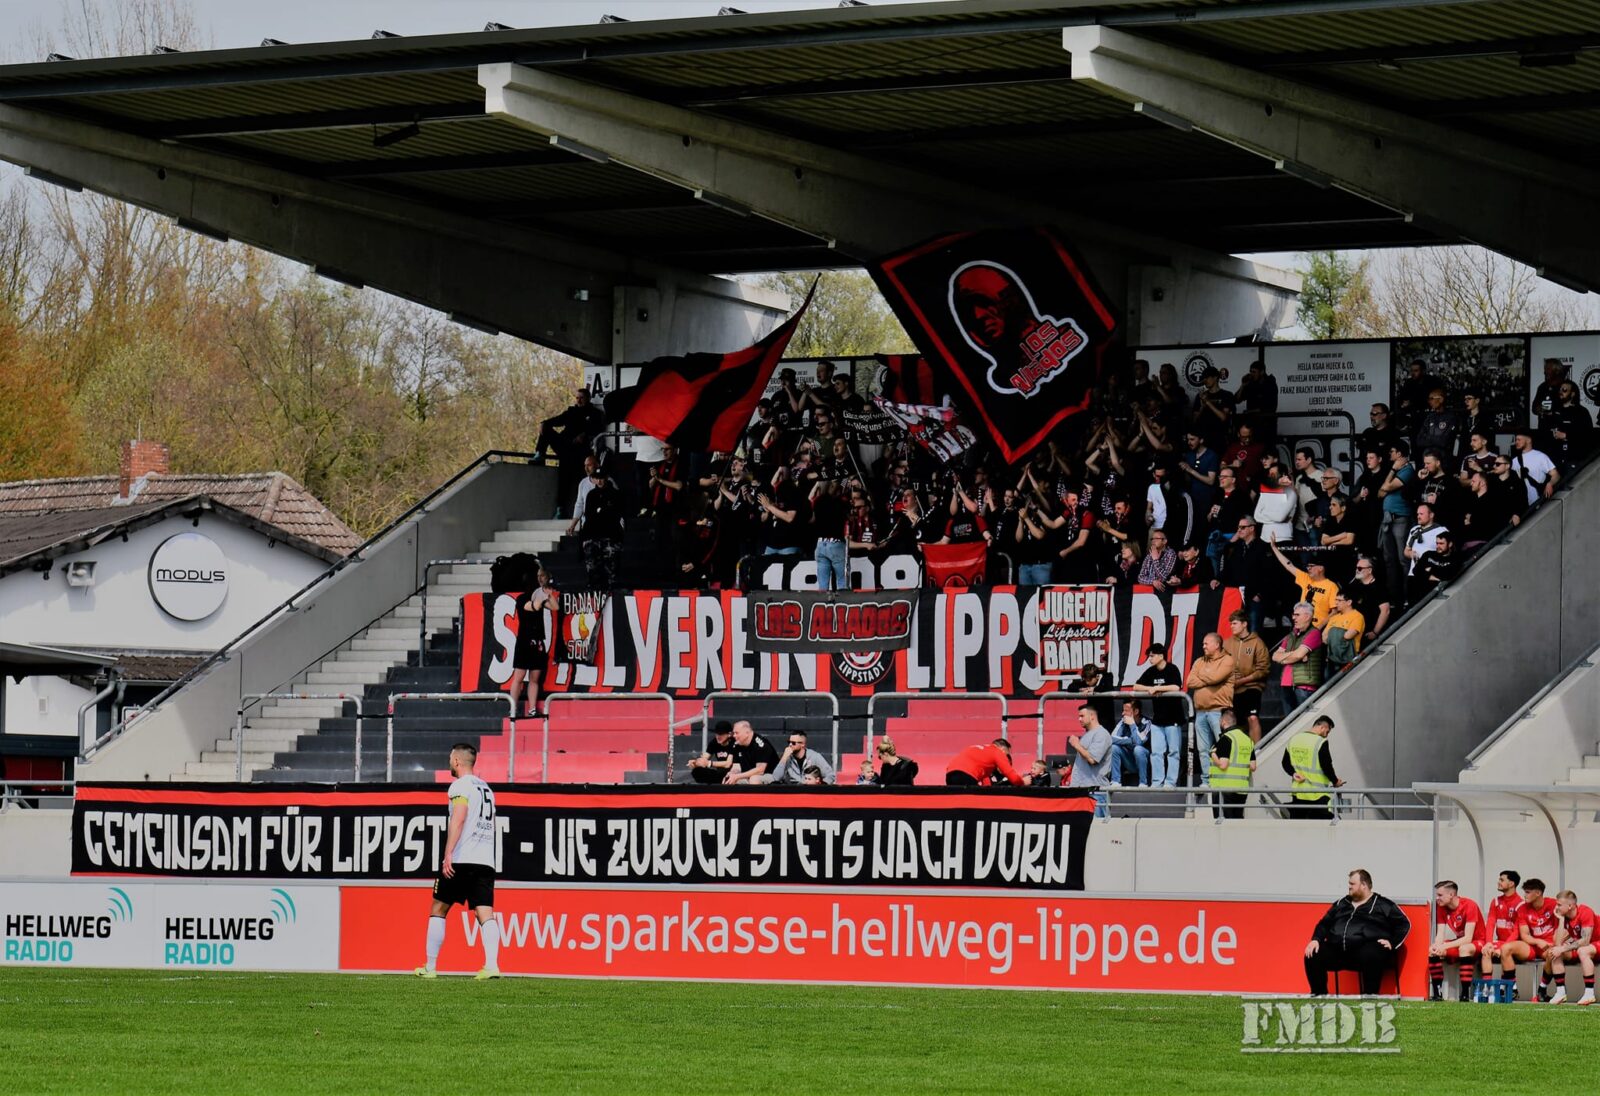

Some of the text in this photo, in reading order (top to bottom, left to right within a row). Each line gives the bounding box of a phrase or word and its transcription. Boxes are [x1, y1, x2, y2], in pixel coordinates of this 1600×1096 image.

[1287, 374, 1308, 382] WILHELM
[1308, 374, 1329, 382] KNEPPER
[1329, 373, 1344, 381] GMBH
[1344, 373, 1348, 381] &
[1358, 373, 1366, 381] KG
[1297, 362, 1311, 371] HELLA
[1280, 386, 1295, 394] FRANZ
[1357, 384, 1372, 392] GMBH
[1311, 420, 1340, 428] HBPO GMBH
[156, 568, 225, 582] MODUS
[1039, 590, 1109, 623] JUGEND
[755, 600, 912, 641] LOS ALIADOS
[1043, 624, 1105, 642] Lippstadt
[1043, 639, 1105, 670] BANDE
[838, 660, 885, 683] LIPPSTADT
[477, 786, 492, 821] 15
[84, 811, 251, 871] GEMEINSAM
[259, 806, 323, 872] FÜR
[332, 816, 510, 873] LIPPSTT
[545, 817, 597, 876] NIE
[607, 808, 740, 877] ZURÜCK
[750, 818, 864, 879] STETS
[872, 819, 965, 880] NACH
[974, 820, 1070, 884] VORN
[6, 914, 112, 939] HELLWEG
[165, 917, 275, 941] HELLWEG
[461, 900, 1238, 976] www.sparkasse-hellweg-lippe.de
[5, 939, 73, 962] RADIO
[164, 942, 235, 965] RADIO
